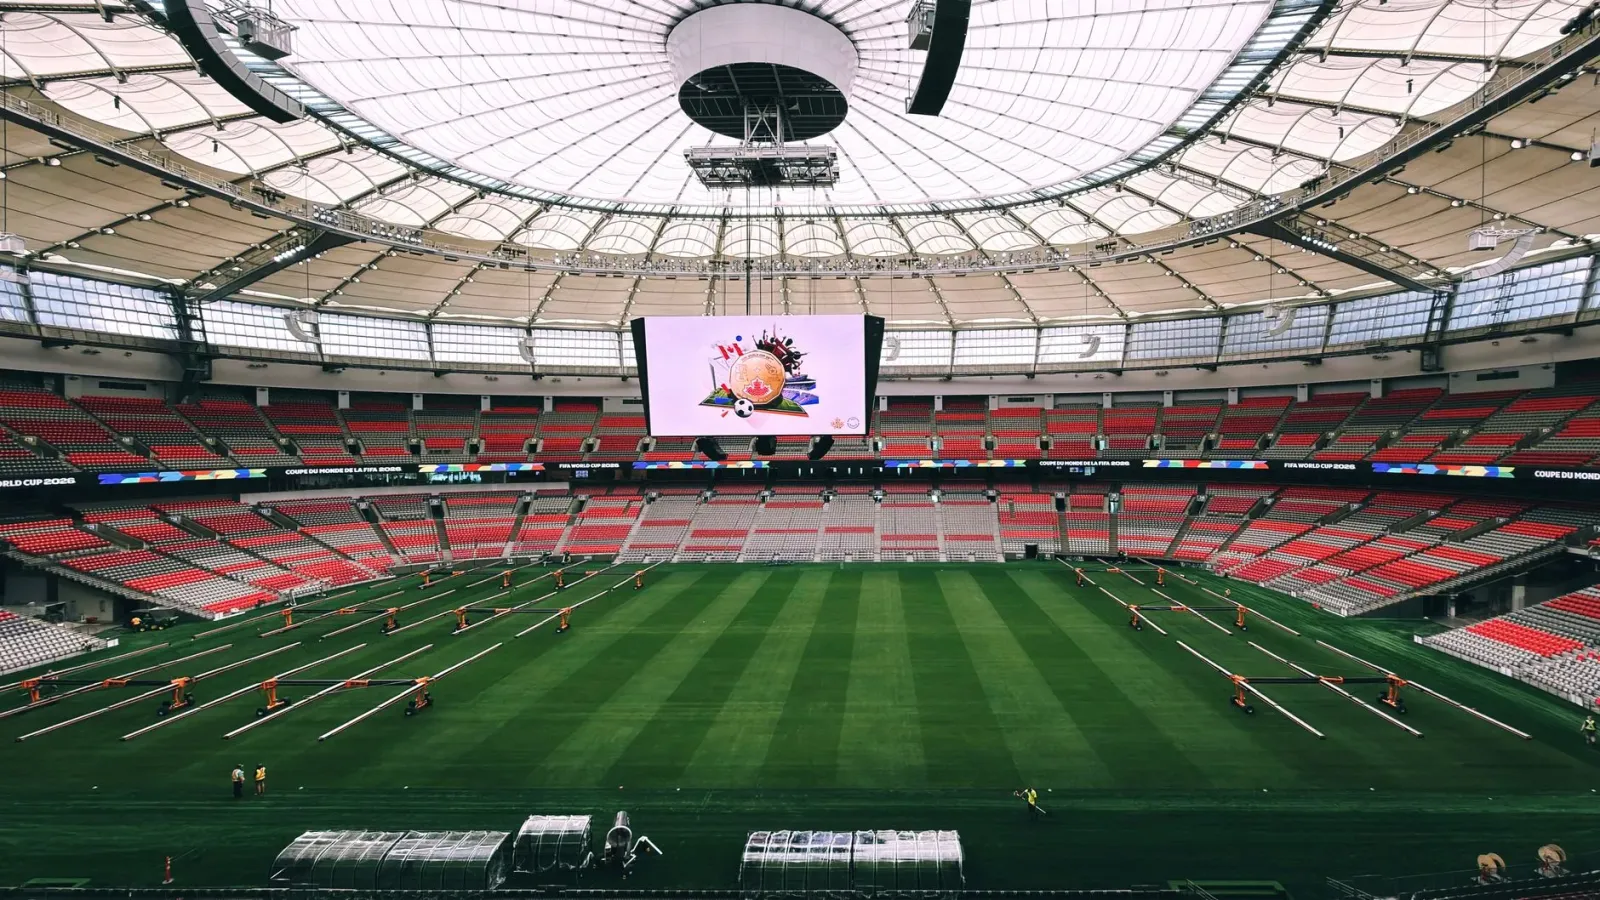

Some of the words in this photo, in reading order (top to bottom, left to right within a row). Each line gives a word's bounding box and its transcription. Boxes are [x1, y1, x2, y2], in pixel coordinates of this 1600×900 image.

[1534, 470, 1560, 478] COUPE
[1561, 471, 1574, 479] DU
[1574, 472, 1600, 480] MOND
[43, 477, 76, 485] 2026
